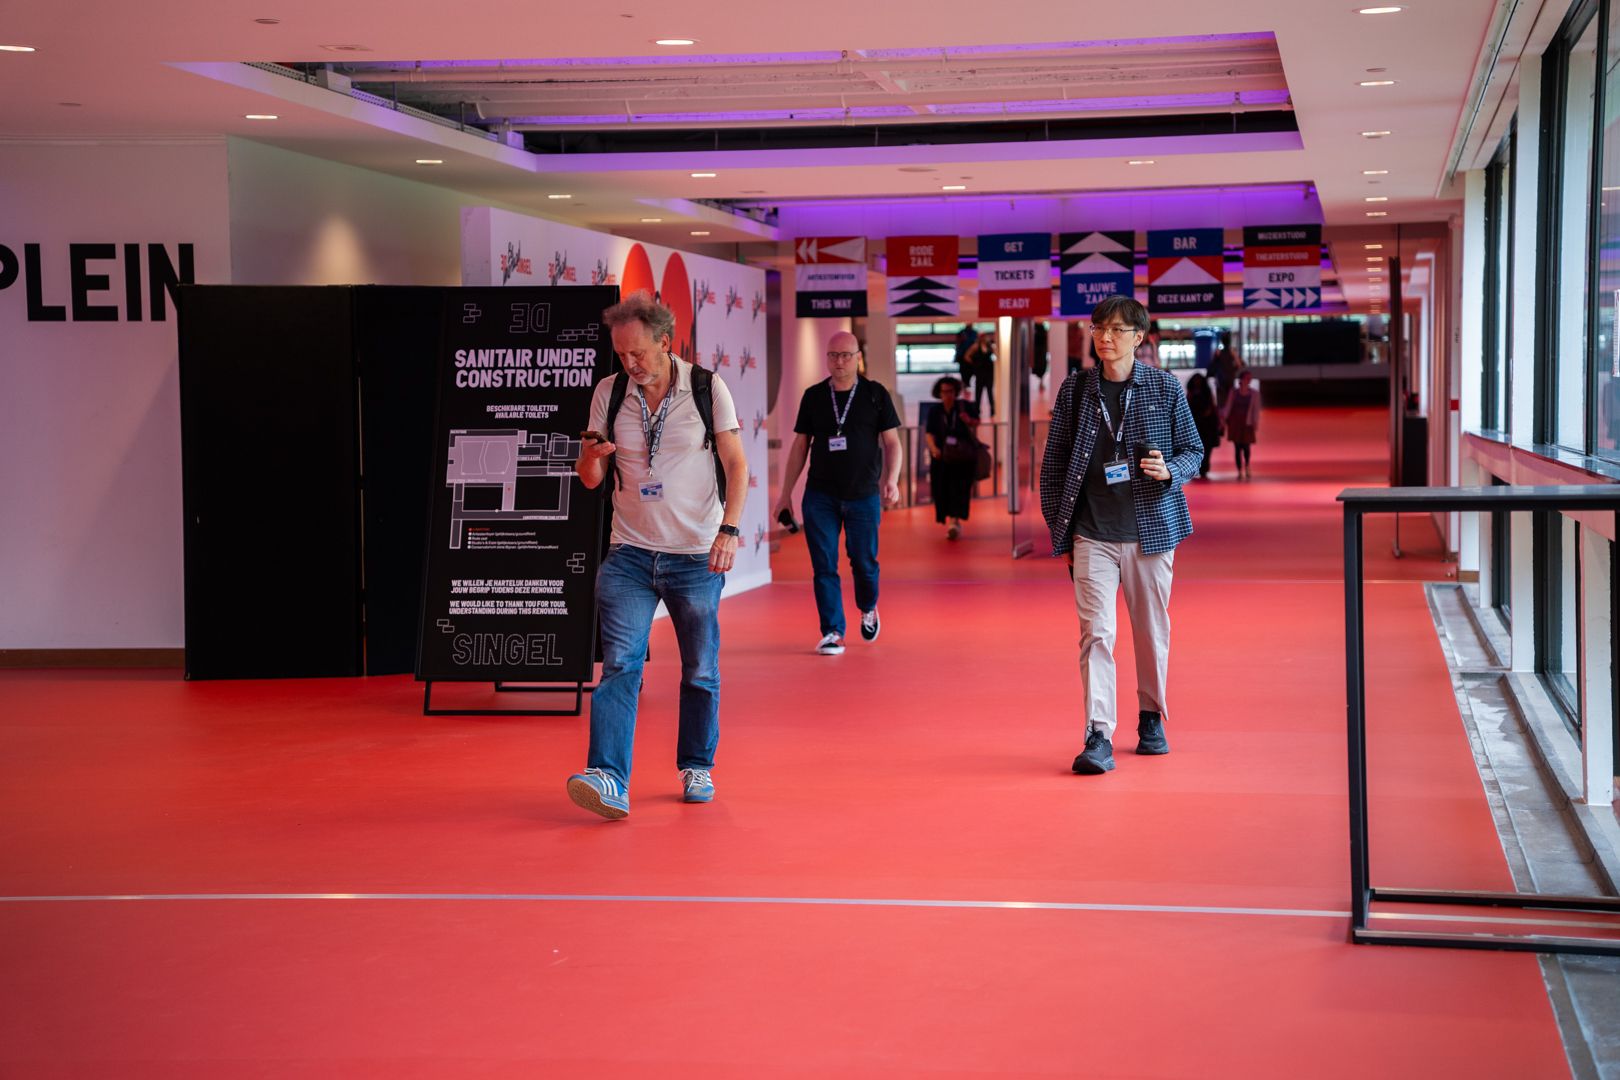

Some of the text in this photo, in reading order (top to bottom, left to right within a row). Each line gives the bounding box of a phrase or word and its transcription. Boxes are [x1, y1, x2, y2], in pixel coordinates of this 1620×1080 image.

[1004, 242, 1024, 253] GET
[1173, 237, 1197, 250] BAR
[909, 245, 934, 256] RODE
[910, 256, 934, 268] ZAAL
[995, 270, 1035, 281] TICKETS
[1268, 272, 1295, 283] EXPO
[1077, 282, 1117, 294] BLAUWE
[811, 298, 852, 309] THIS WAY
[999, 298, 1030, 309] READY
[1157, 293, 1214, 304] DEZE KANT OP
[454, 348, 597, 368] SANITAIR UNDER
[455, 368, 593, 388] CONSTRUCTION
[524, 579, 548, 587] DANKEN
[548, 579, 564, 587] VOOR
[452, 633, 564, 666] SINGEL
